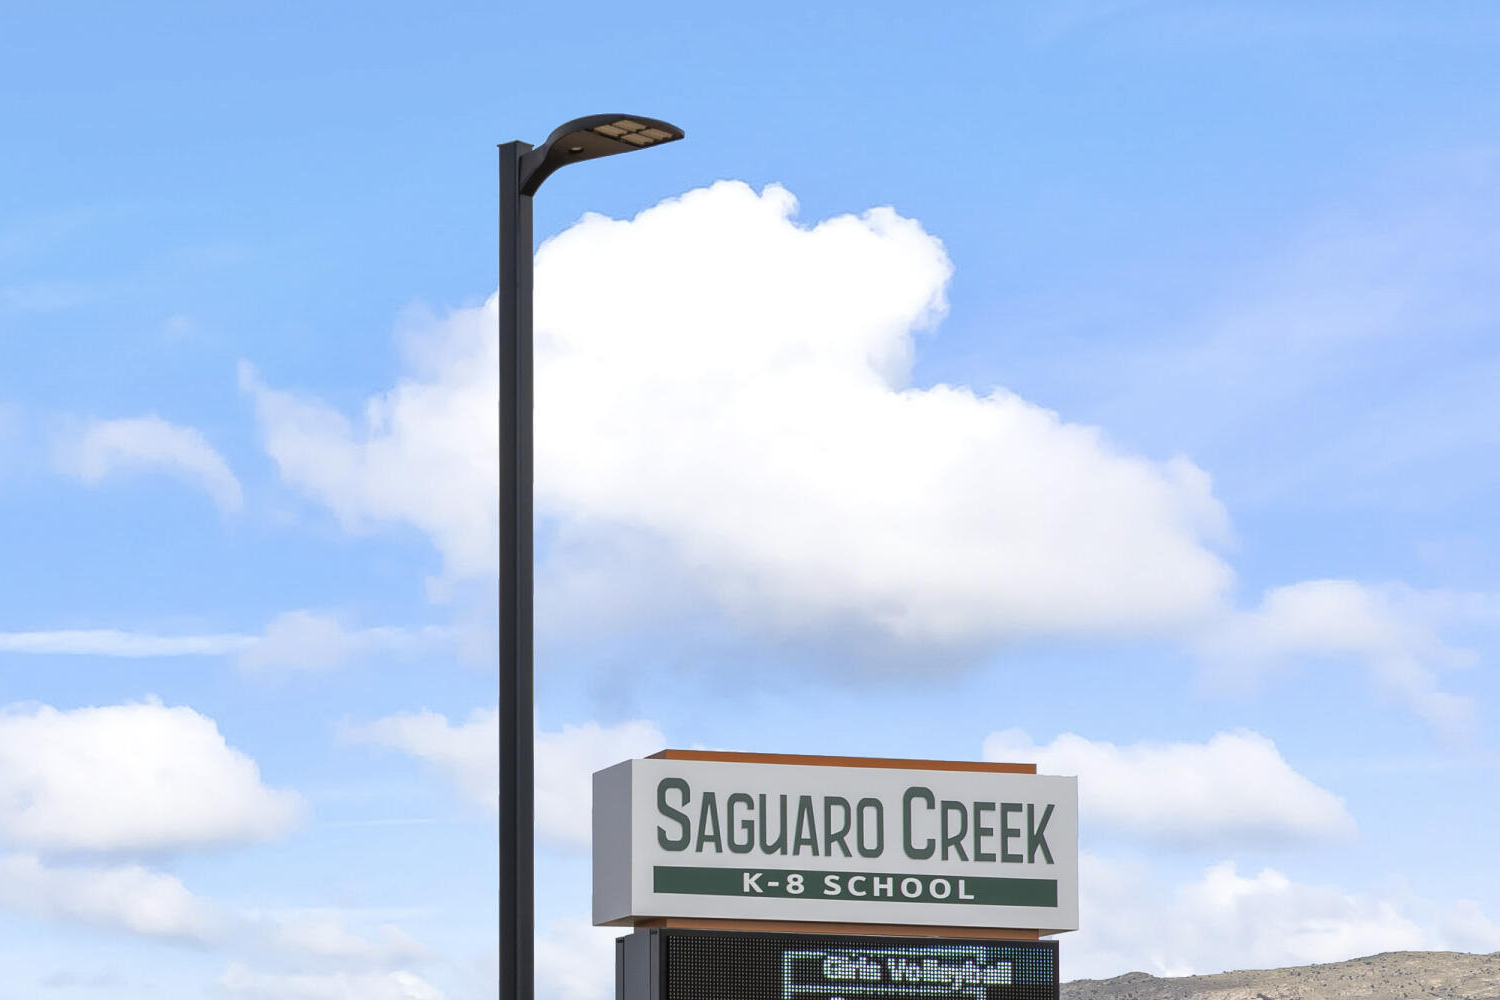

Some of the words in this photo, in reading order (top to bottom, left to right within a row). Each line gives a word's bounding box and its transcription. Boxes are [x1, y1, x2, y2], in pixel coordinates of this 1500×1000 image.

[656, 777, 884, 858] SAGUARO
[902, 786, 1055, 865] CREEK
[742, 872, 805, 894] K-8
[823, 874, 975, 900] SCHOOL
[823, 956, 881, 980] Girls
